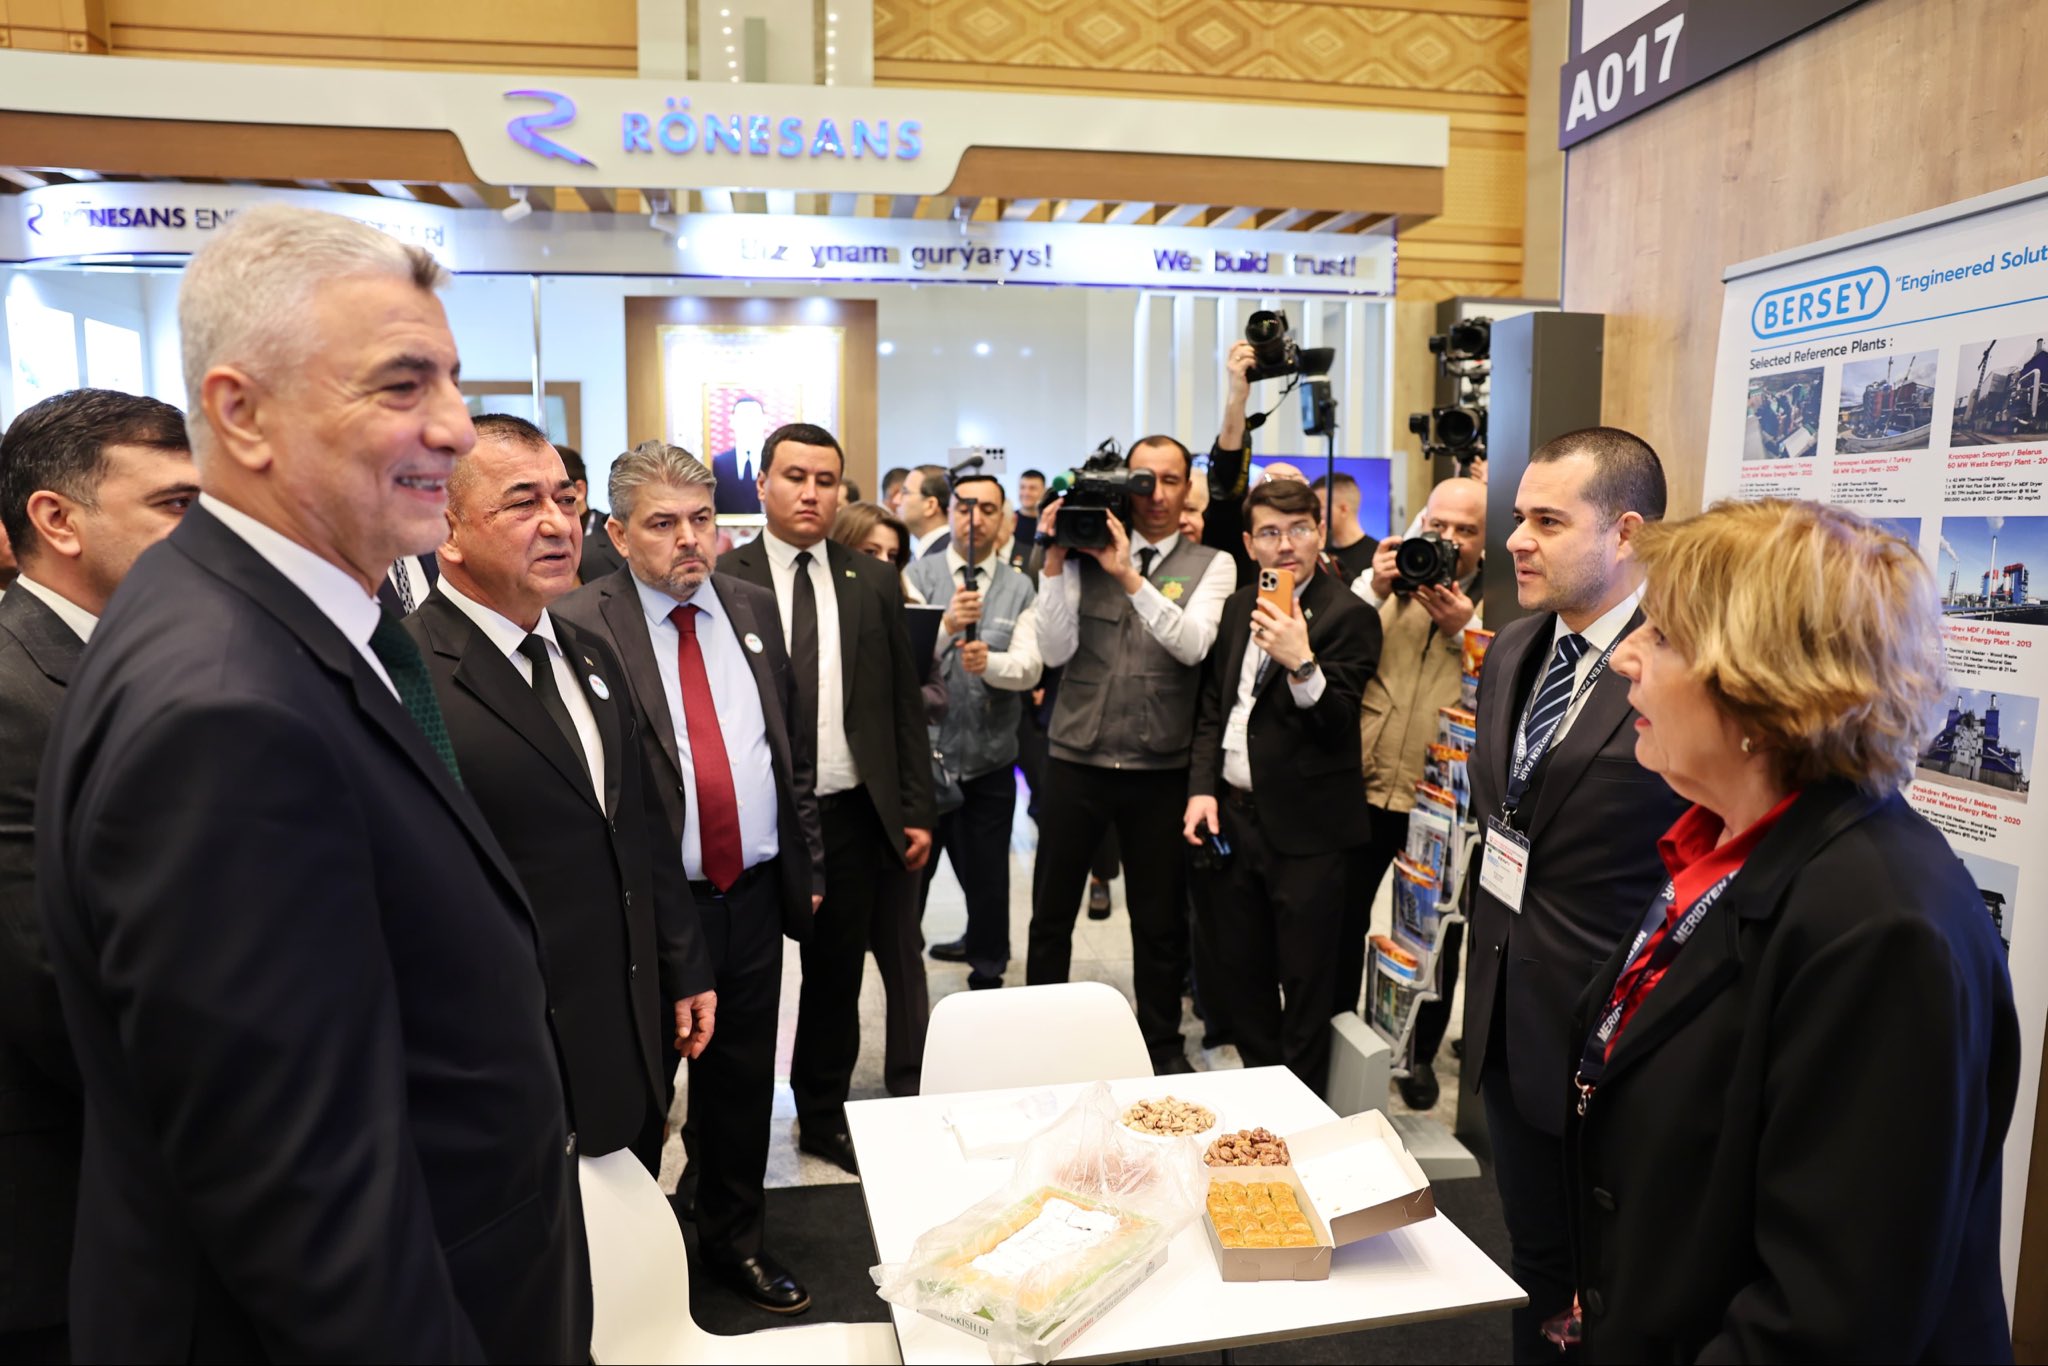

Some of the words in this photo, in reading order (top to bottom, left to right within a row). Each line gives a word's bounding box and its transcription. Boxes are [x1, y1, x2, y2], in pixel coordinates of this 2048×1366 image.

[1565, 13, 1684, 132] A017
[622, 96, 923, 160] RÖNESANS
[1154, 249, 1192, 272] We
[2000, 245, 2048, 270] Solut
[1763, 278, 1874, 329] BERSEY
[1749, 351, 1792, 371] Selected
[1793, 343, 1847, 364] Reference
[1851, 337, 1887, 354] Plants
[1970, 635, 1991, 644] Energy
[1994, 638, 2009, 646] Plant
[1987, 628, 2010, 636] Belarus
[1517, 760, 1534, 781] FAIR
[1939, 799, 1957, 810] Waste
[1958, 806, 1979, 816] Energy
[1982, 810, 1997, 820] Plant
[2004, 816, 2021, 826] 2020
[1942, 792, 1967, 803] Plywood
[1974, 799, 1997, 810] Belarus
[1672, 878, 1727, 945] MERIDYEN
